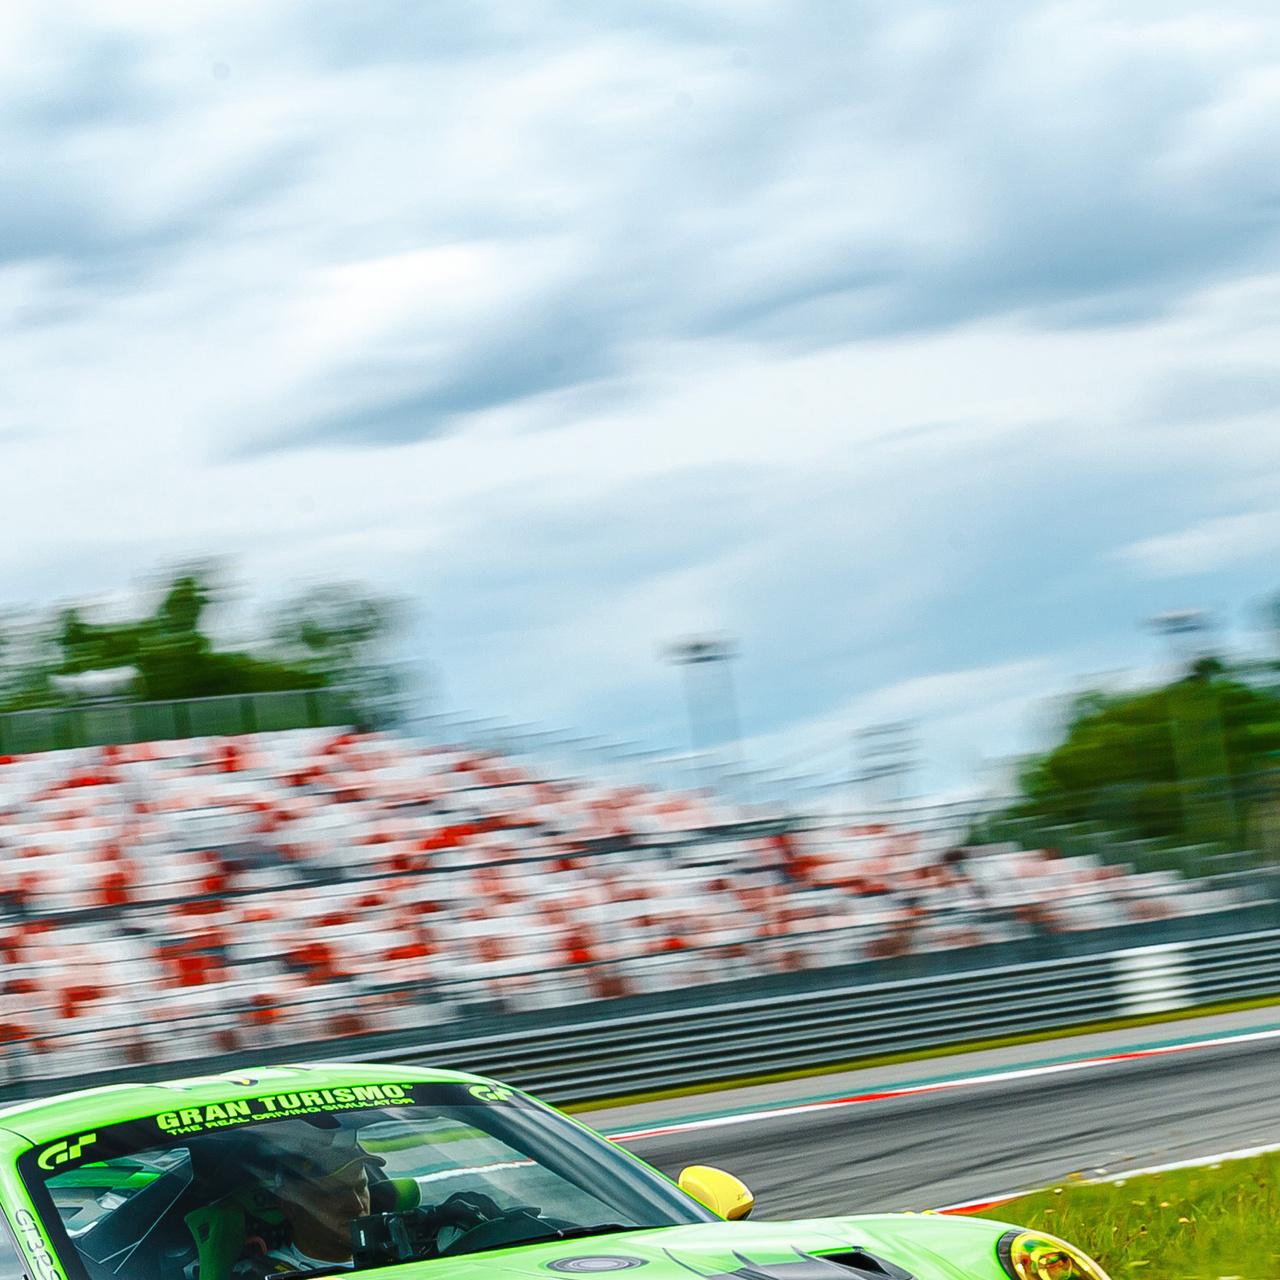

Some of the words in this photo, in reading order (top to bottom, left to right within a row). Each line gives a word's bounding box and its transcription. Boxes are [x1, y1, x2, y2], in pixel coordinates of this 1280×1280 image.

[156, 1098, 251, 1130] GRAN
[166, 1124, 203, 1135] THE
[204, 1117, 250, 1129] REAL
[251, 1106, 322, 1121] DRIVING
[321, 1098, 415, 1111] SIMULATOR
